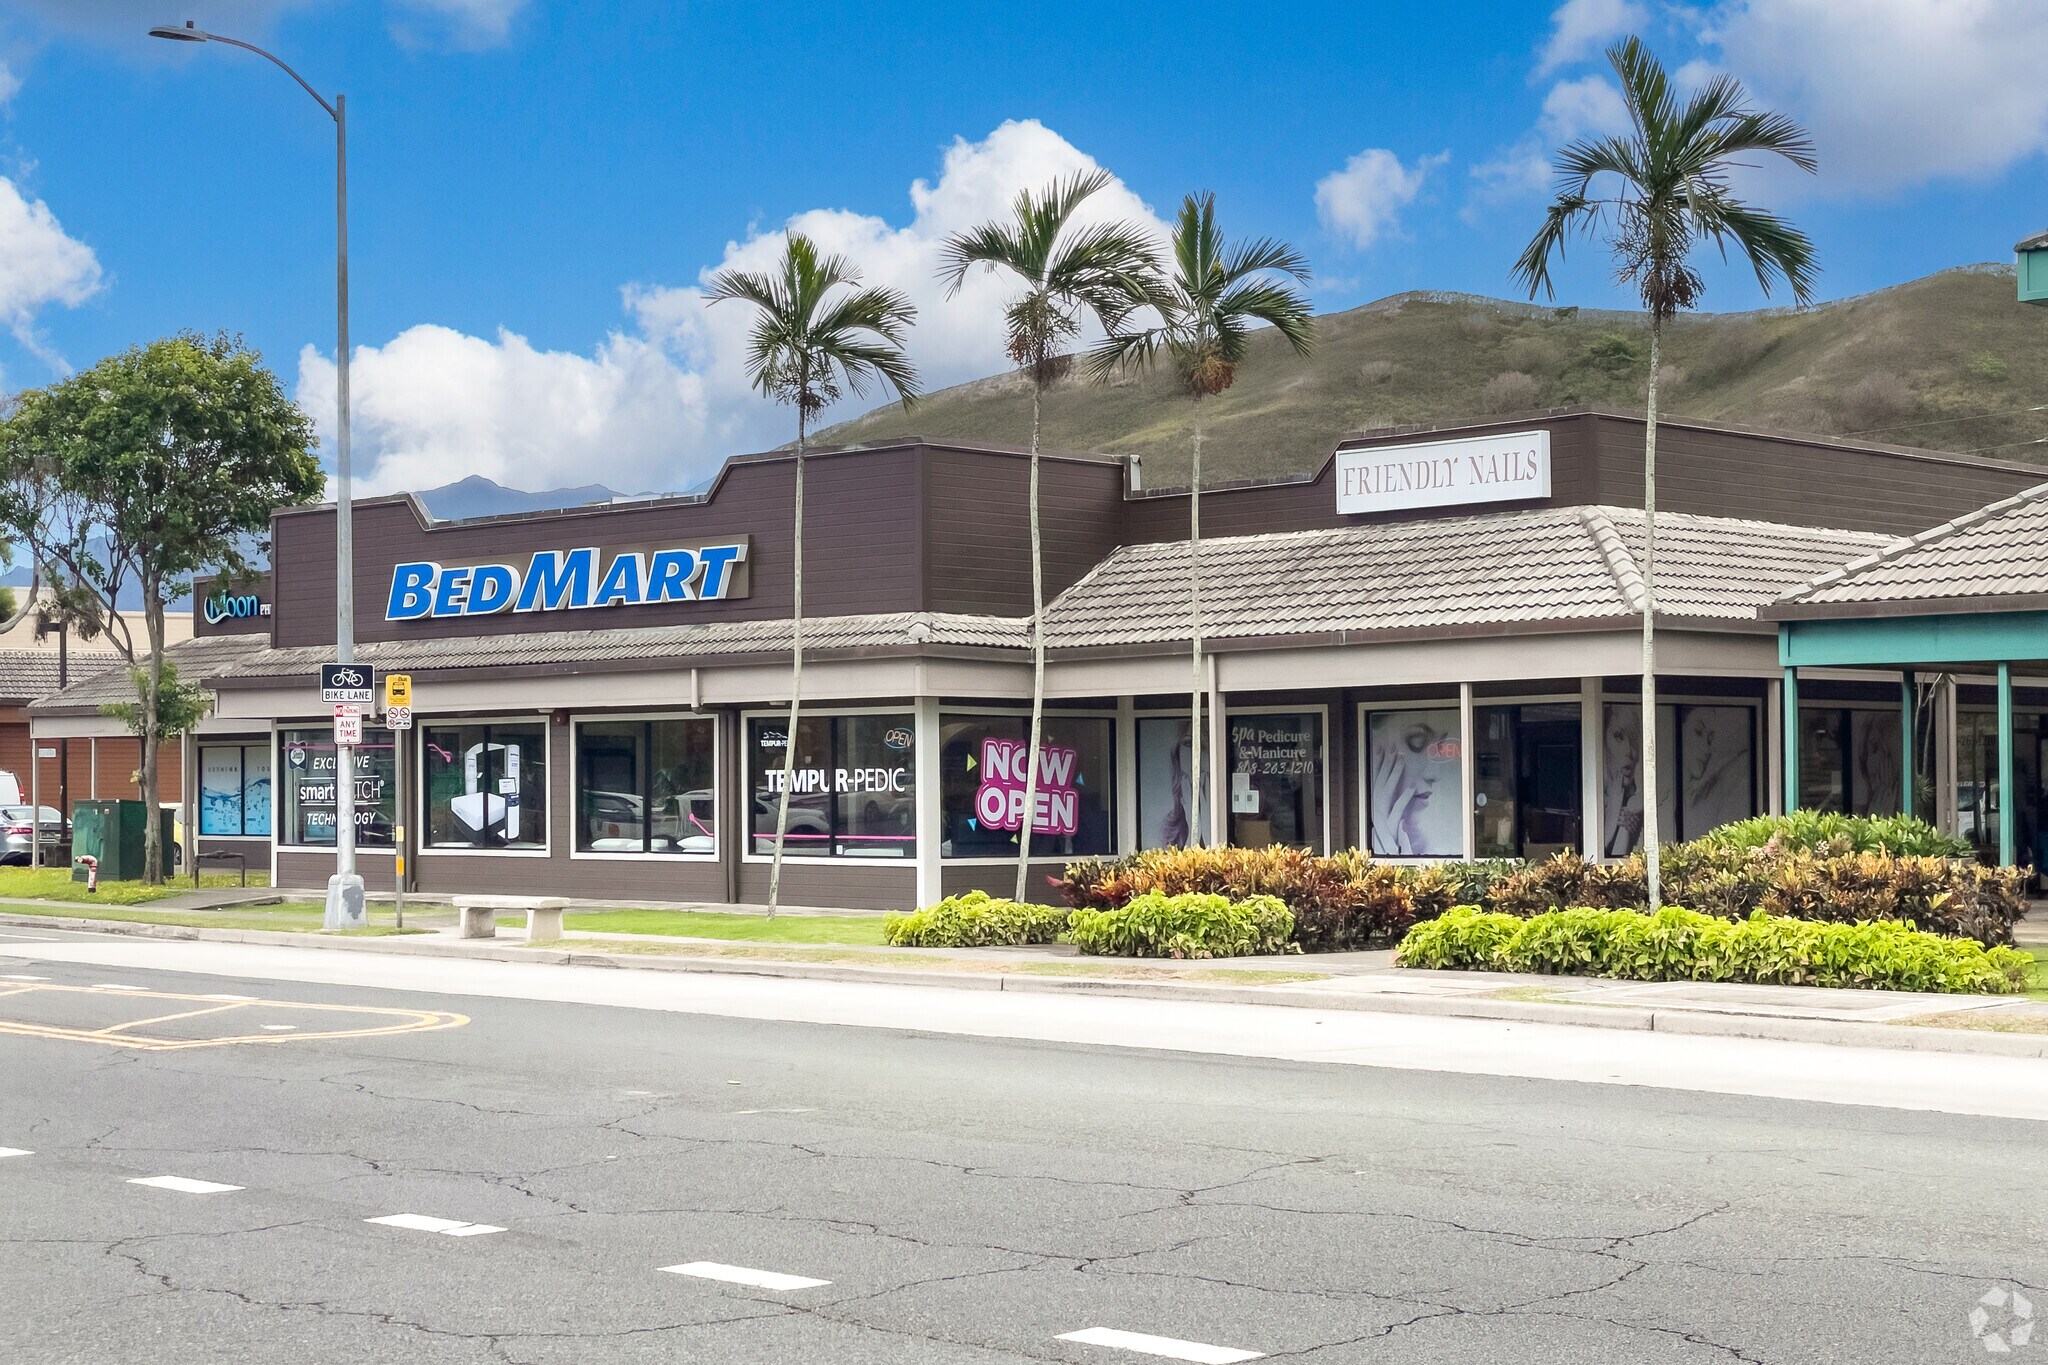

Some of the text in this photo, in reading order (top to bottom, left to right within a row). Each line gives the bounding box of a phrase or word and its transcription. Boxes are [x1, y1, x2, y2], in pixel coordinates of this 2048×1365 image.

[1343, 449, 1538, 497] FRIENDLY NAILS
[325, 691, 370, 700] BIKE LANE
[340, 720, 356, 728] ANY
[886, 730, 913, 748] OPEN
[1258, 730, 1311, 743] Pedicure
[1251, 746, 1307, 759] Manicure
[986, 745, 1073, 786] NOW
[1237, 760, 1313, 774] 808-263-1210
[980, 787, 1074, 829] OPEN
[306, 811, 376, 825] TECHNOGY
